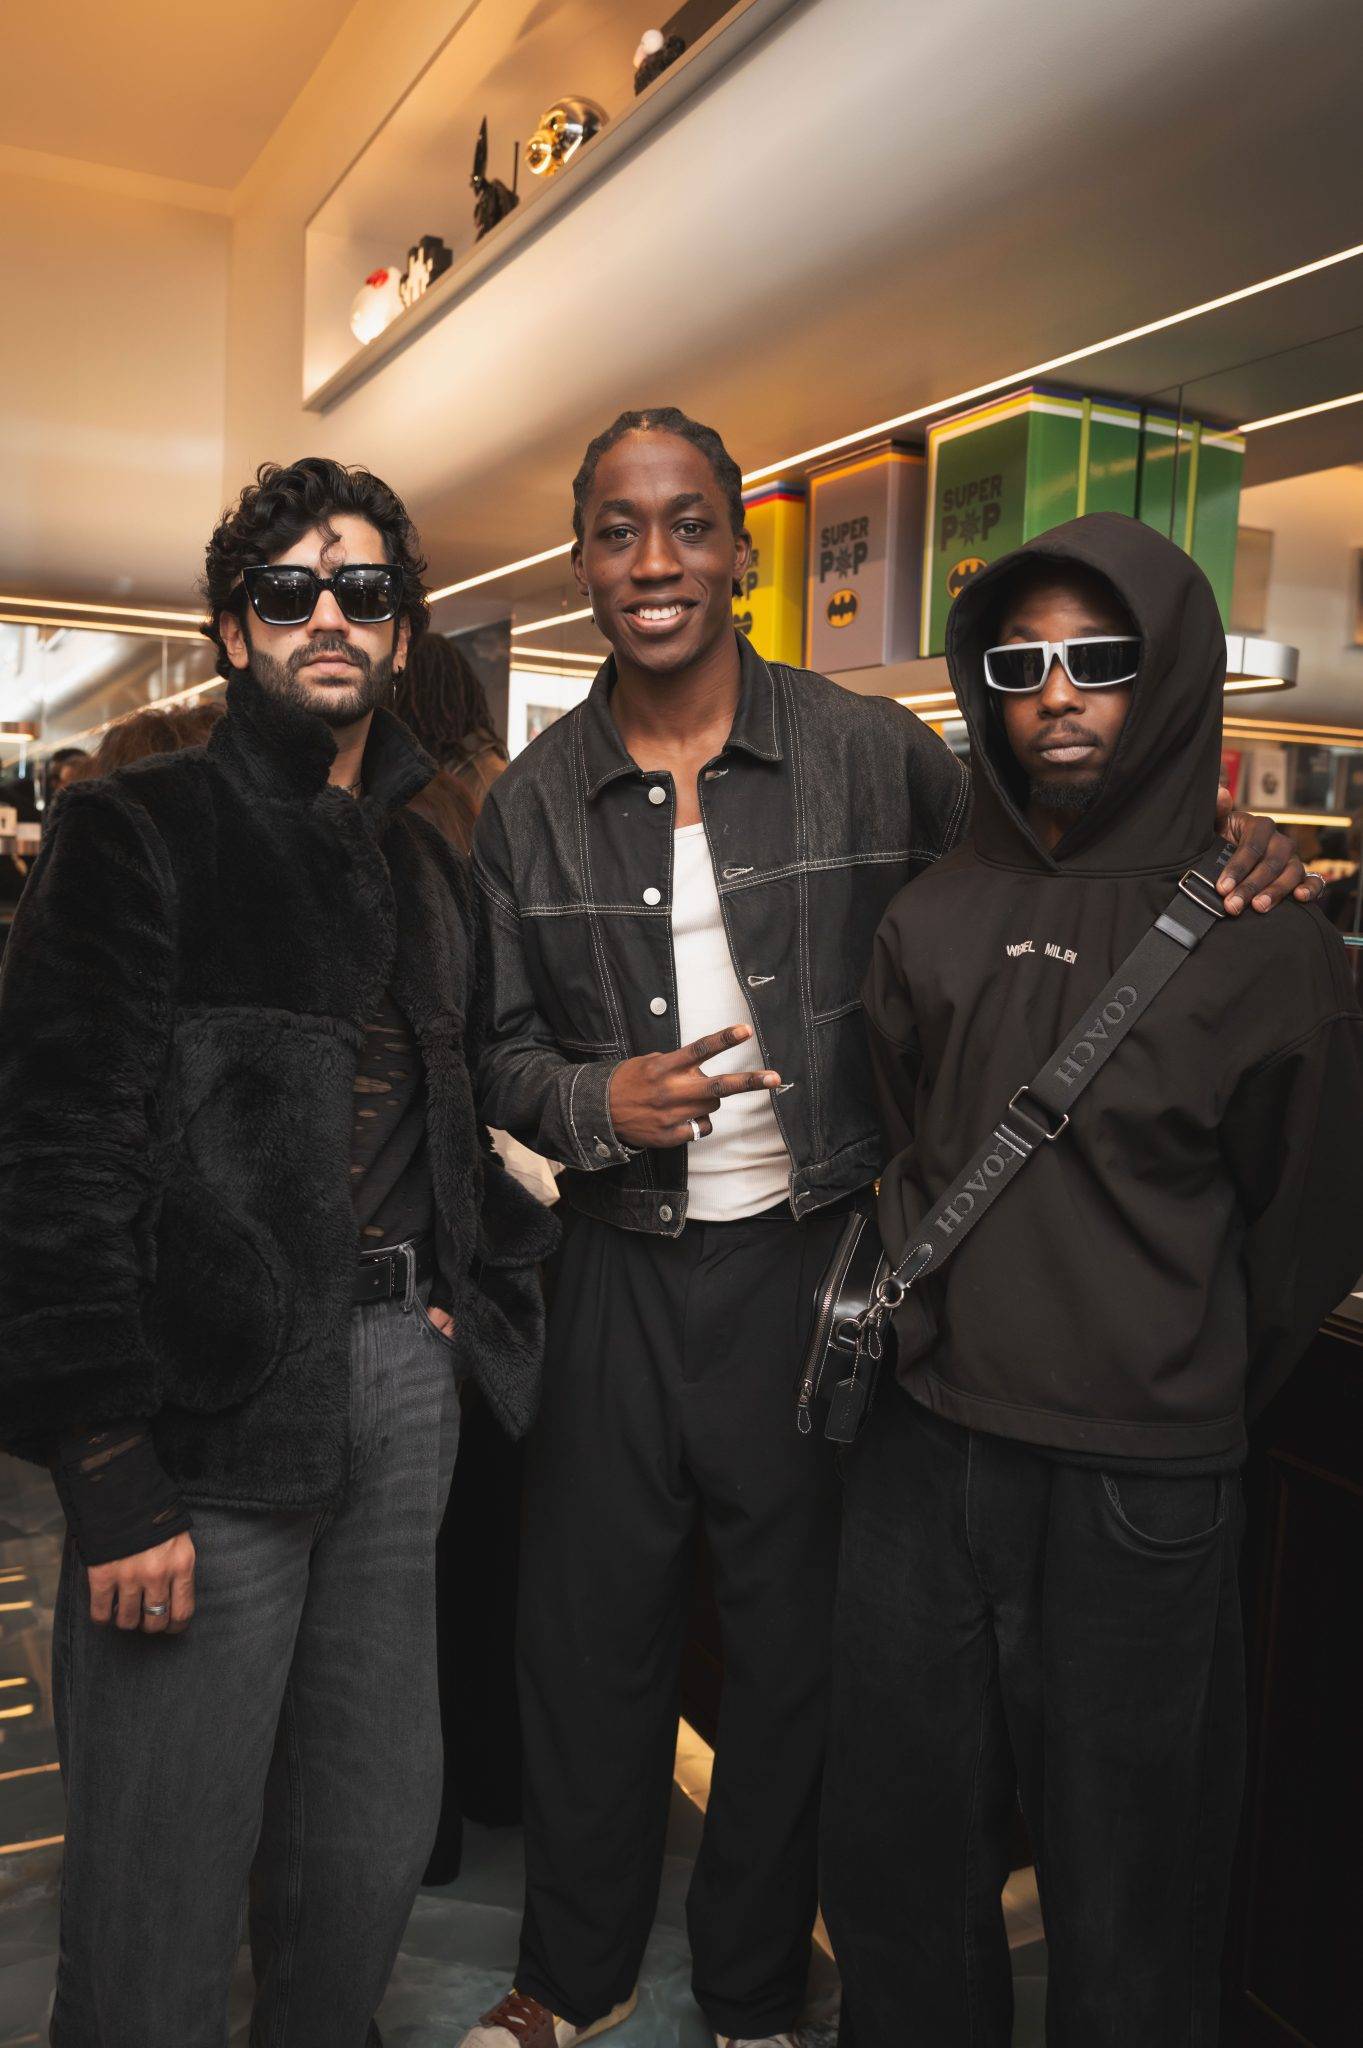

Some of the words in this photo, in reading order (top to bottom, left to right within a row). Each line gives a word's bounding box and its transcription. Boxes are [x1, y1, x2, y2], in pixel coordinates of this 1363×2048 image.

[942, 473, 1002, 512] SUPER
[821, 515, 869, 549] SUPER
[1054, 985, 1138, 1088] COACH
